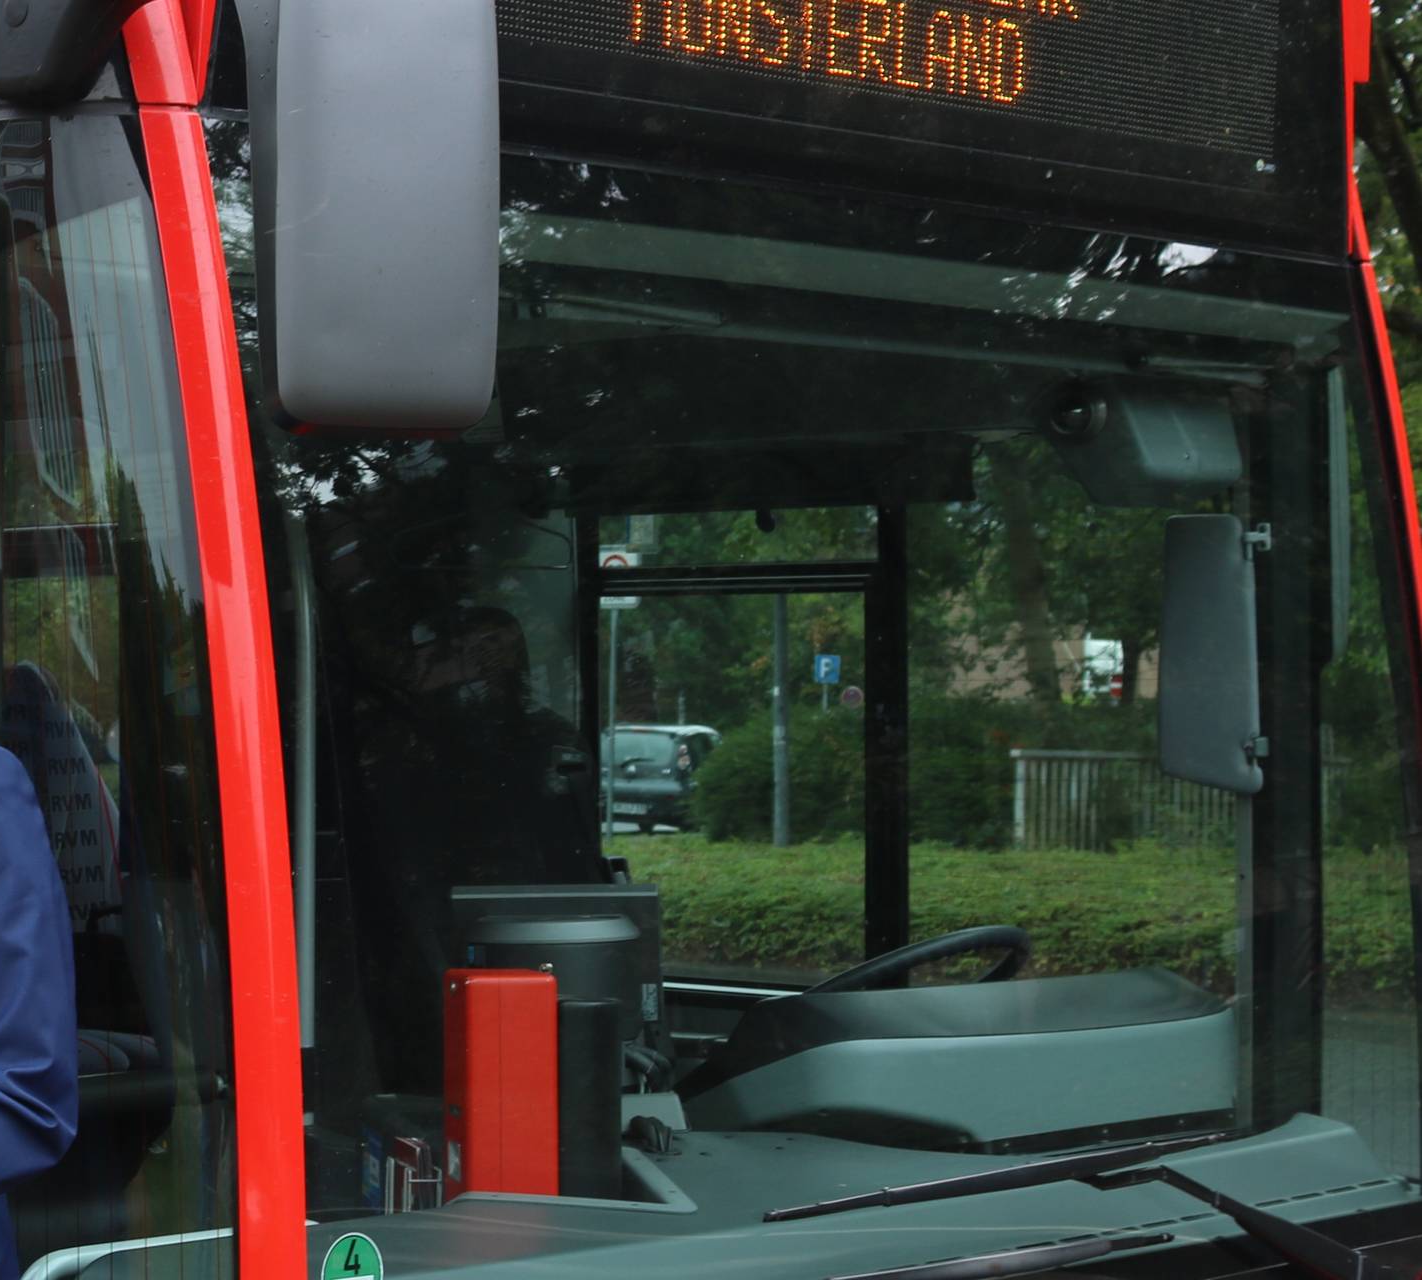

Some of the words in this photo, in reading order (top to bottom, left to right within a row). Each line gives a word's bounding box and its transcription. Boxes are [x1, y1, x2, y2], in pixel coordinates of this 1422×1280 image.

[820, 657, 834, 679] P
[48, 758, 87, 776] RVM
[52, 793, 92, 812] RVM
[54, 829, 98, 849] RVM
[344, 1239, 361, 1275] 4
